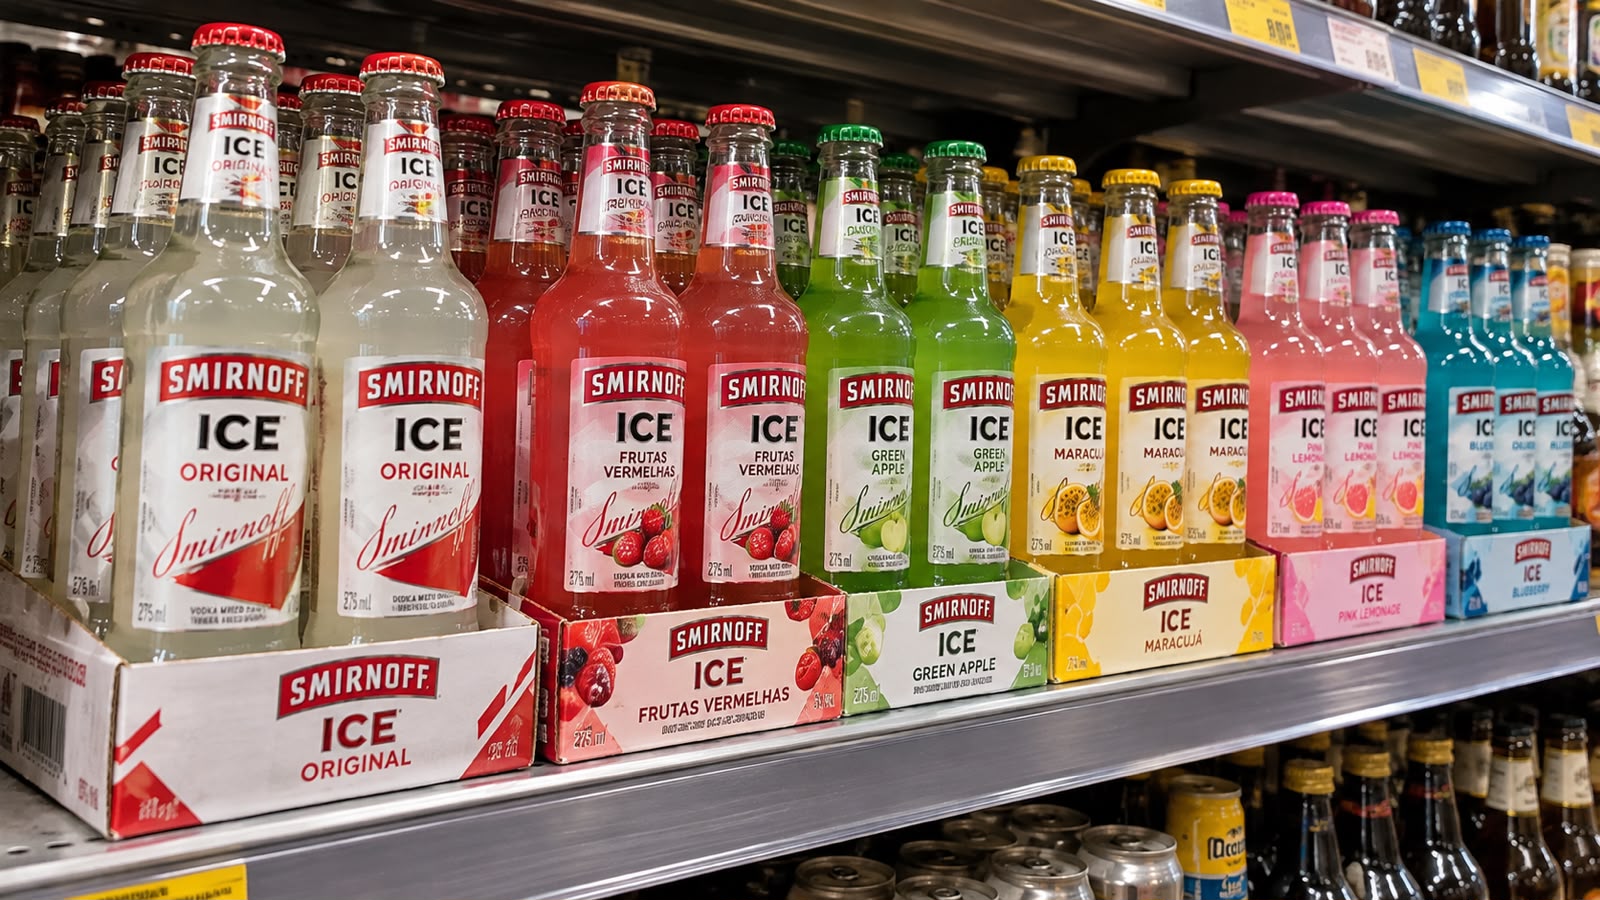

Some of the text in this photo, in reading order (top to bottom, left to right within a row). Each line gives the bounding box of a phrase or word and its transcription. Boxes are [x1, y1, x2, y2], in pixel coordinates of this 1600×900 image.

[224, 136, 265, 159] ICE
[401, 157, 435, 177] ICE
[335, 172, 357, 189] IC
[617, 178, 647, 197] ICE
[17, 200, 33, 214] IC
[531, 189, 560, 208] ICE
[743, 195, 768, 212] ICE
[669, 203, 695, 220] ICE
[856, 208, 879, 224] ICE
[962, 219, 984, 236] ICE
[1054, 231, 1074, 246] ICE
[1076, 248, 1089, 261] CE
[1335, 264, 1348, 275] IC
[1385, 271, 1396, 281] IC
[1457, 278, 1468, 288] IC
[1498, 285, 1509, 294] IC
[169, 362, 304, 398] SMIRNOFF
[367, 370, 481, 400] SMIRNOFF
[950, 381, 1014, 403] SMIRNOF
[1136, 387, 1186, 406] SMIRNO
[1285, 389, 1325, 408] SMIRN
[1338, 391, 1377, 409] SMIRN
[1388, 392, 1426, 410] SMIRN
[198, 414, 280, 450] ICE
[395, 417, 463, 451] ICE
[616, 412, 673, 443] ICE
[751, 415, 798, 443] ICE
[869, 415, 910, 442] ICE
[970, 416, 1009, 441] ICE
[1066, 416, 1102, 440] ICE
[1155, 418, 1184, 440] ICE
[1220, 418, 1247, 439] ICE
[620, 451, 667, 464] FRUTAS
[755, 451, 794, 463] FRUTAS
[872, 450, 905, 462] GREEN
[973, 448, 1005, 460] GREEN
[1144, 447, 1184, 459] MARACU
[180, 463, 288, 482] ORIGINAL
[380, 462, 469, 480] ORIGINAL
[604, 466, 675, 479] VERMELHAS
[739, 464, 799, 477] VERMELHAS
[872, 463, 905, 475] APPLE
[973, 460, 1004, 473] APPLE
[724, 563, 732, 577] ml
[1352, 557, 1396, 578] SMIRNOFF
[1524, 564, 1541, 582] ICE
[585, 572, 594, 586] ml
[1148, 578, 1206, 602] SMIRNOFF
[1362, 583, 1384, 603] ICE
[924, 600, 991, 623] SMIRNOFF
[1160, 608, 1191, 633] ICE
[1338, 603, 1401, 622] PINK LEMONADE
[677, 621, 763, 651] SMIRNOFF
[938, 629, 977, 657] ICE
[1144, 629, 1203, 653] MARACUJÁ
[694, 656, 744, 690] ICE
[913, 657, 996, 681] GREEN APPLE
[290, 662, 431, 707] SMIRNOFF
[638, 700, 699, 723] FRUTAS
[703, 686, 790, 713] VERMELHAS
[321, 709, 398, 752] ICE
[301, 748, 412, 782] ORIGINAL
